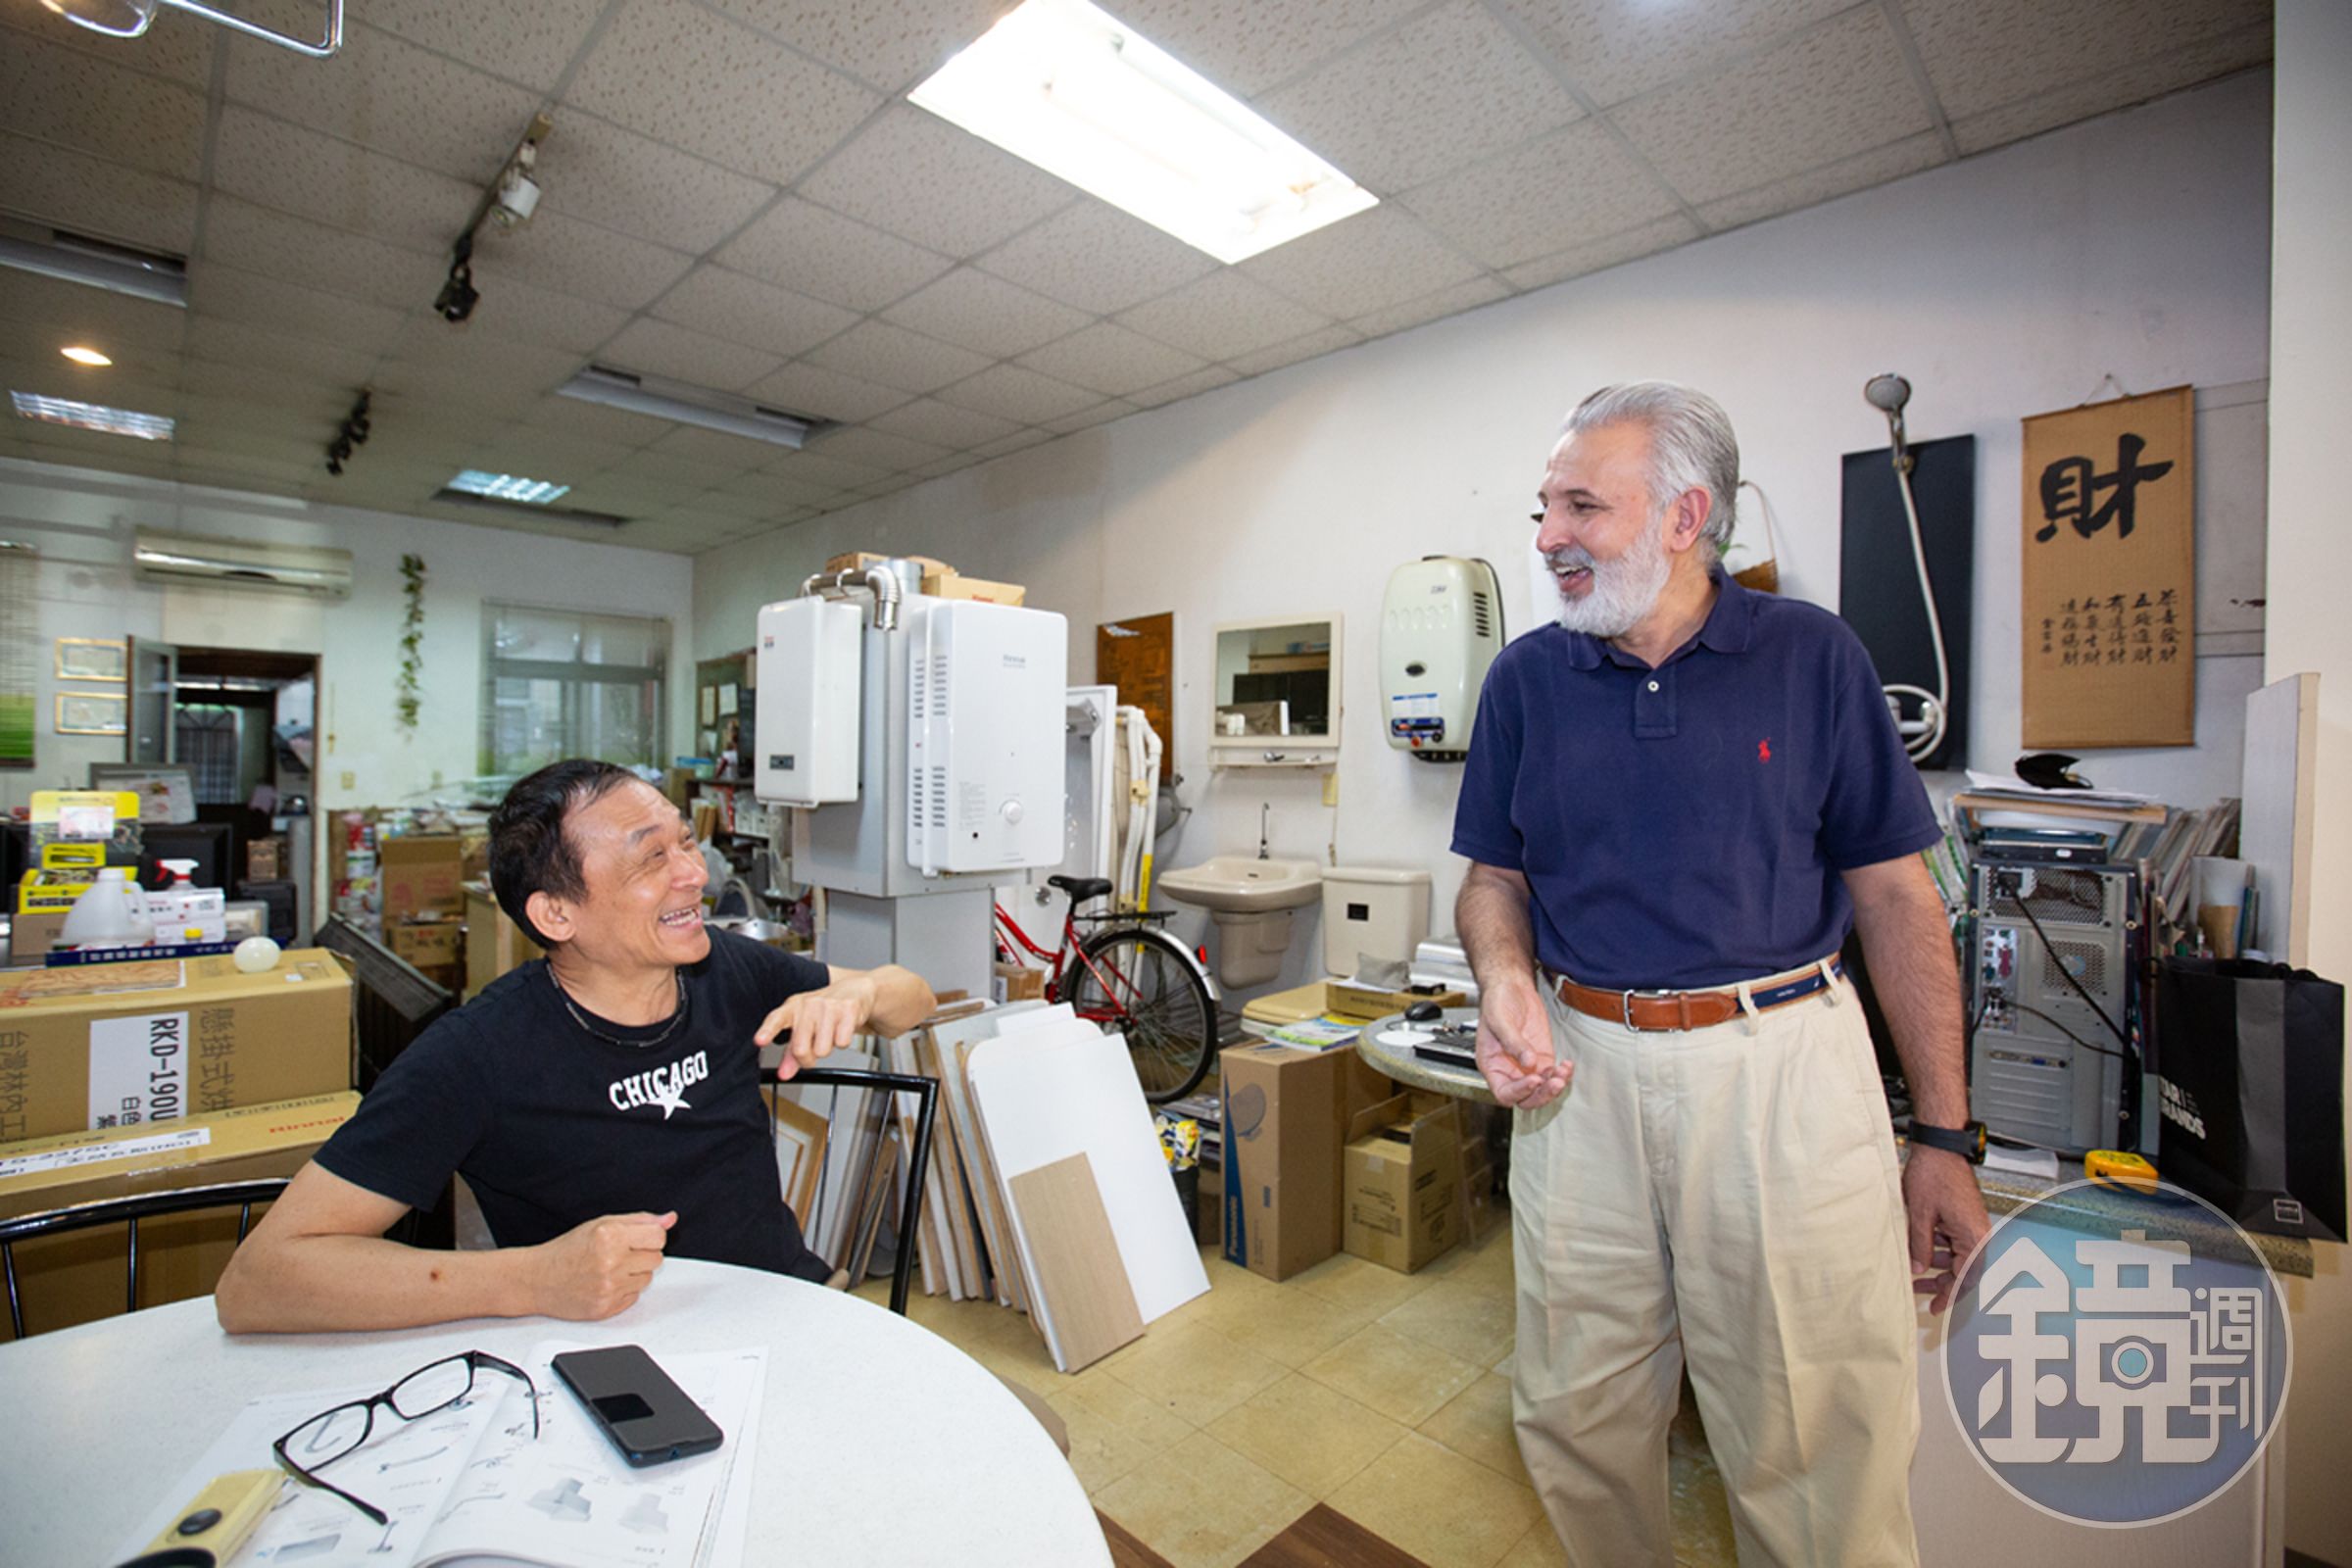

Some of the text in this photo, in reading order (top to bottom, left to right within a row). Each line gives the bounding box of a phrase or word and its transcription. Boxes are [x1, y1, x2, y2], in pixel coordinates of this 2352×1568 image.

[2035, 433, 2175, 543] 財
[0, 1030, 30, 1141] 台灣林內工
[609, 1050, 710, 1111] CHICAGO
